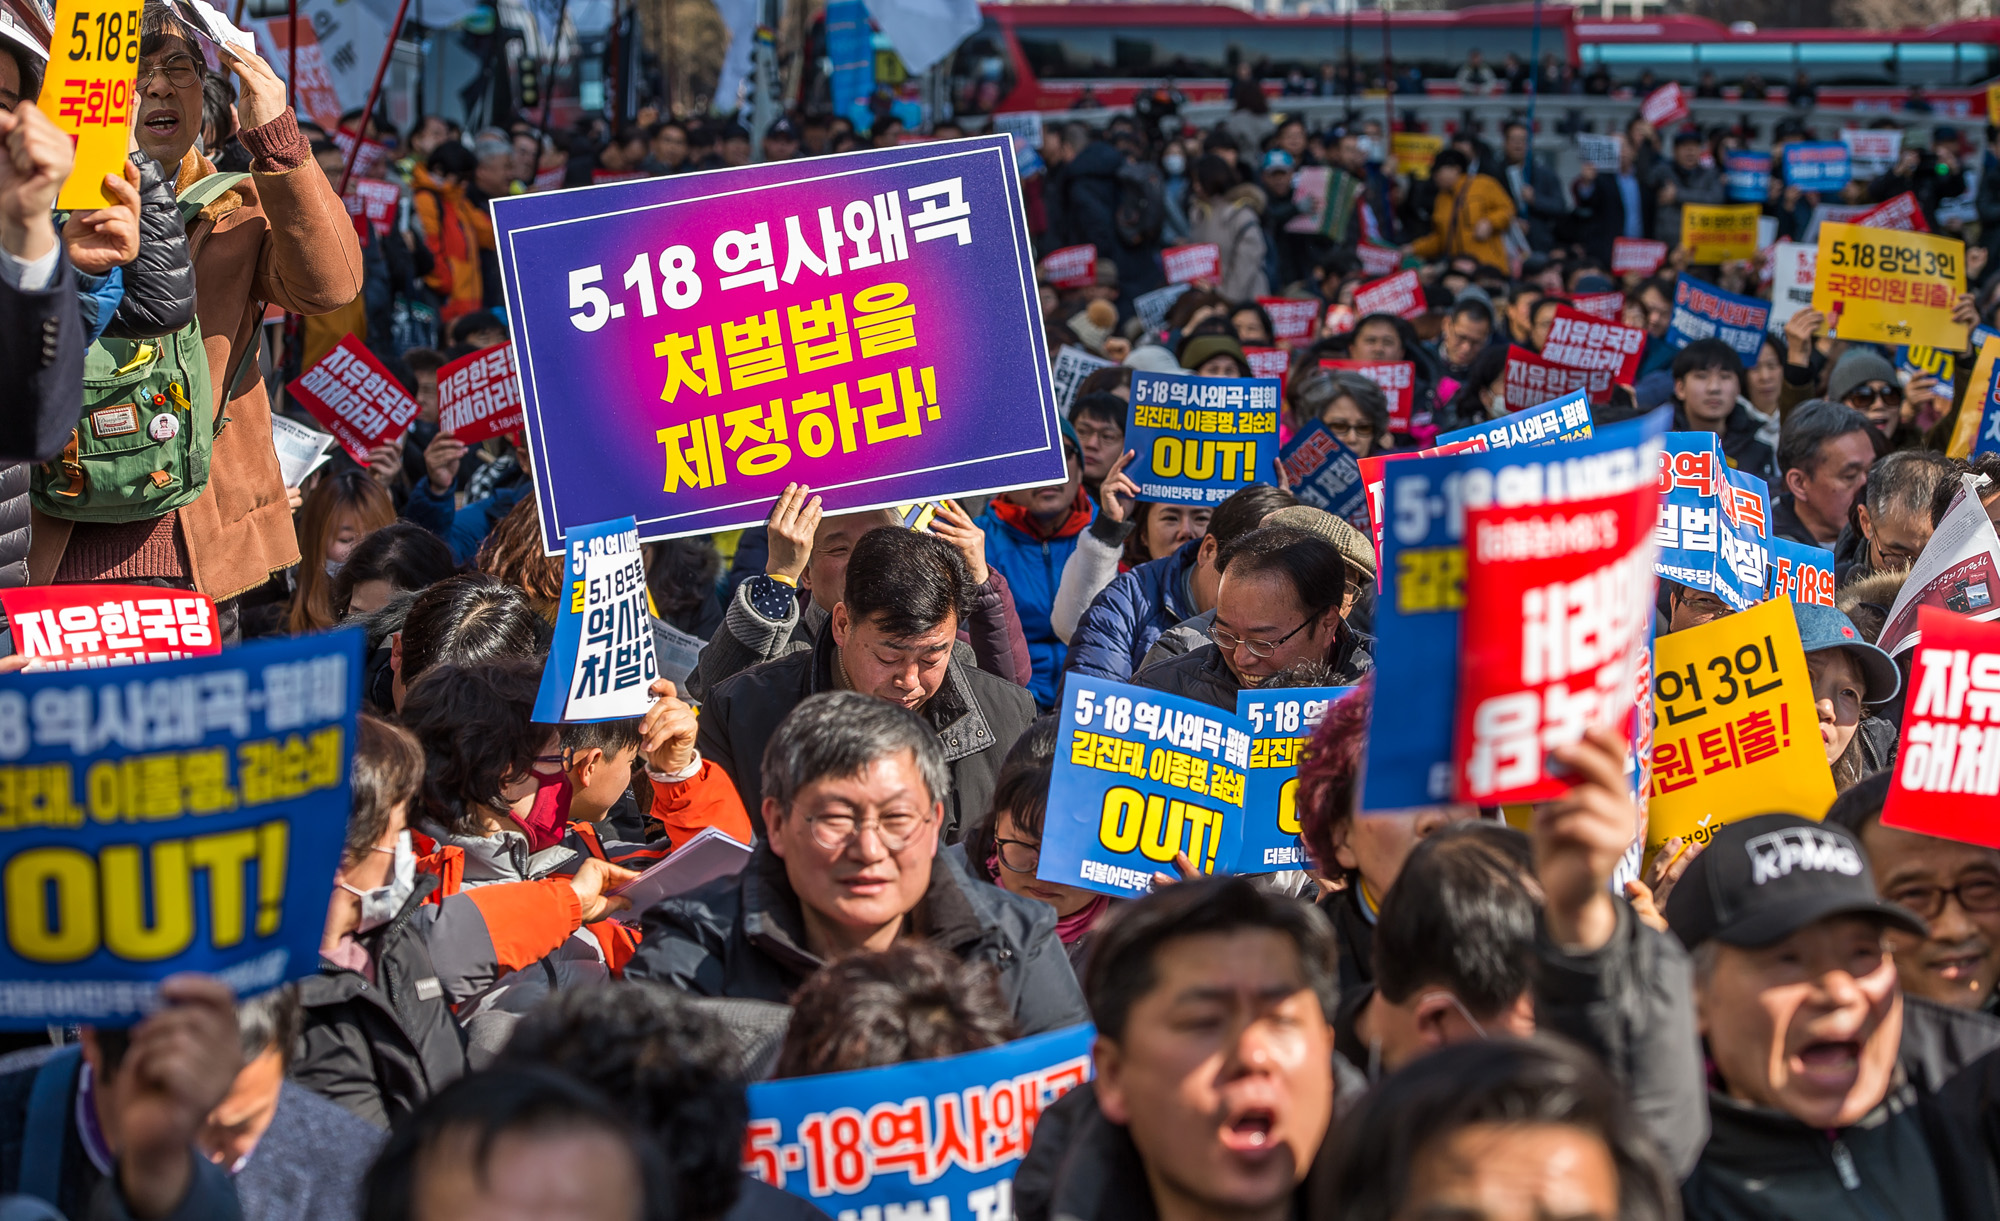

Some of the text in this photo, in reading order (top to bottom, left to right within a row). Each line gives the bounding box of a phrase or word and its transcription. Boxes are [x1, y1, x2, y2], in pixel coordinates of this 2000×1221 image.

[68, 12, 122, 62] 5.18
[568, 244, 703, 333] 5.18
[712, 176, 974, 293] 역사왜곡
[1831, 241, 1875, 269] 5.18
[1879, 245, 1921, 275] 망언
[1924, 251, 1956, 280] 3인
[1828, 272, 1908, 305] 국회의원
[653, 282, 918, 404] 처벌법을
[1541, 342, 1626, 377] 해체하라!
[1548, 316, 1643, 355] 자유한국당
[300, 365, 390, 440] 해체하라!
[321, 344, 418, 427] 자유한국당
[1507, 358, 1612, 392] 자유한국당
[655, 366, 943, 494] 제정하라!
[1134, 405, 1277, 434] 김진태, 이종명, 김순례
[1152, 436, 1257, 482] OUT!
[1141, 484, 1203, 501] 더불어민주당
[14, 598, 212, 658] 자유한국당
[1707, 635, 1784, 706] 3인
[1070, 730, 1148, 780] 김진태,
[1149, 748, 1210, 796] 이종명,
[1210, 763, 1246, 809] 김순례
[1697, 702, 1791, 777] 퇴출!
[1098, 785, 1225, 876] OUT!
[4, 819, 290, 964] OUT!
